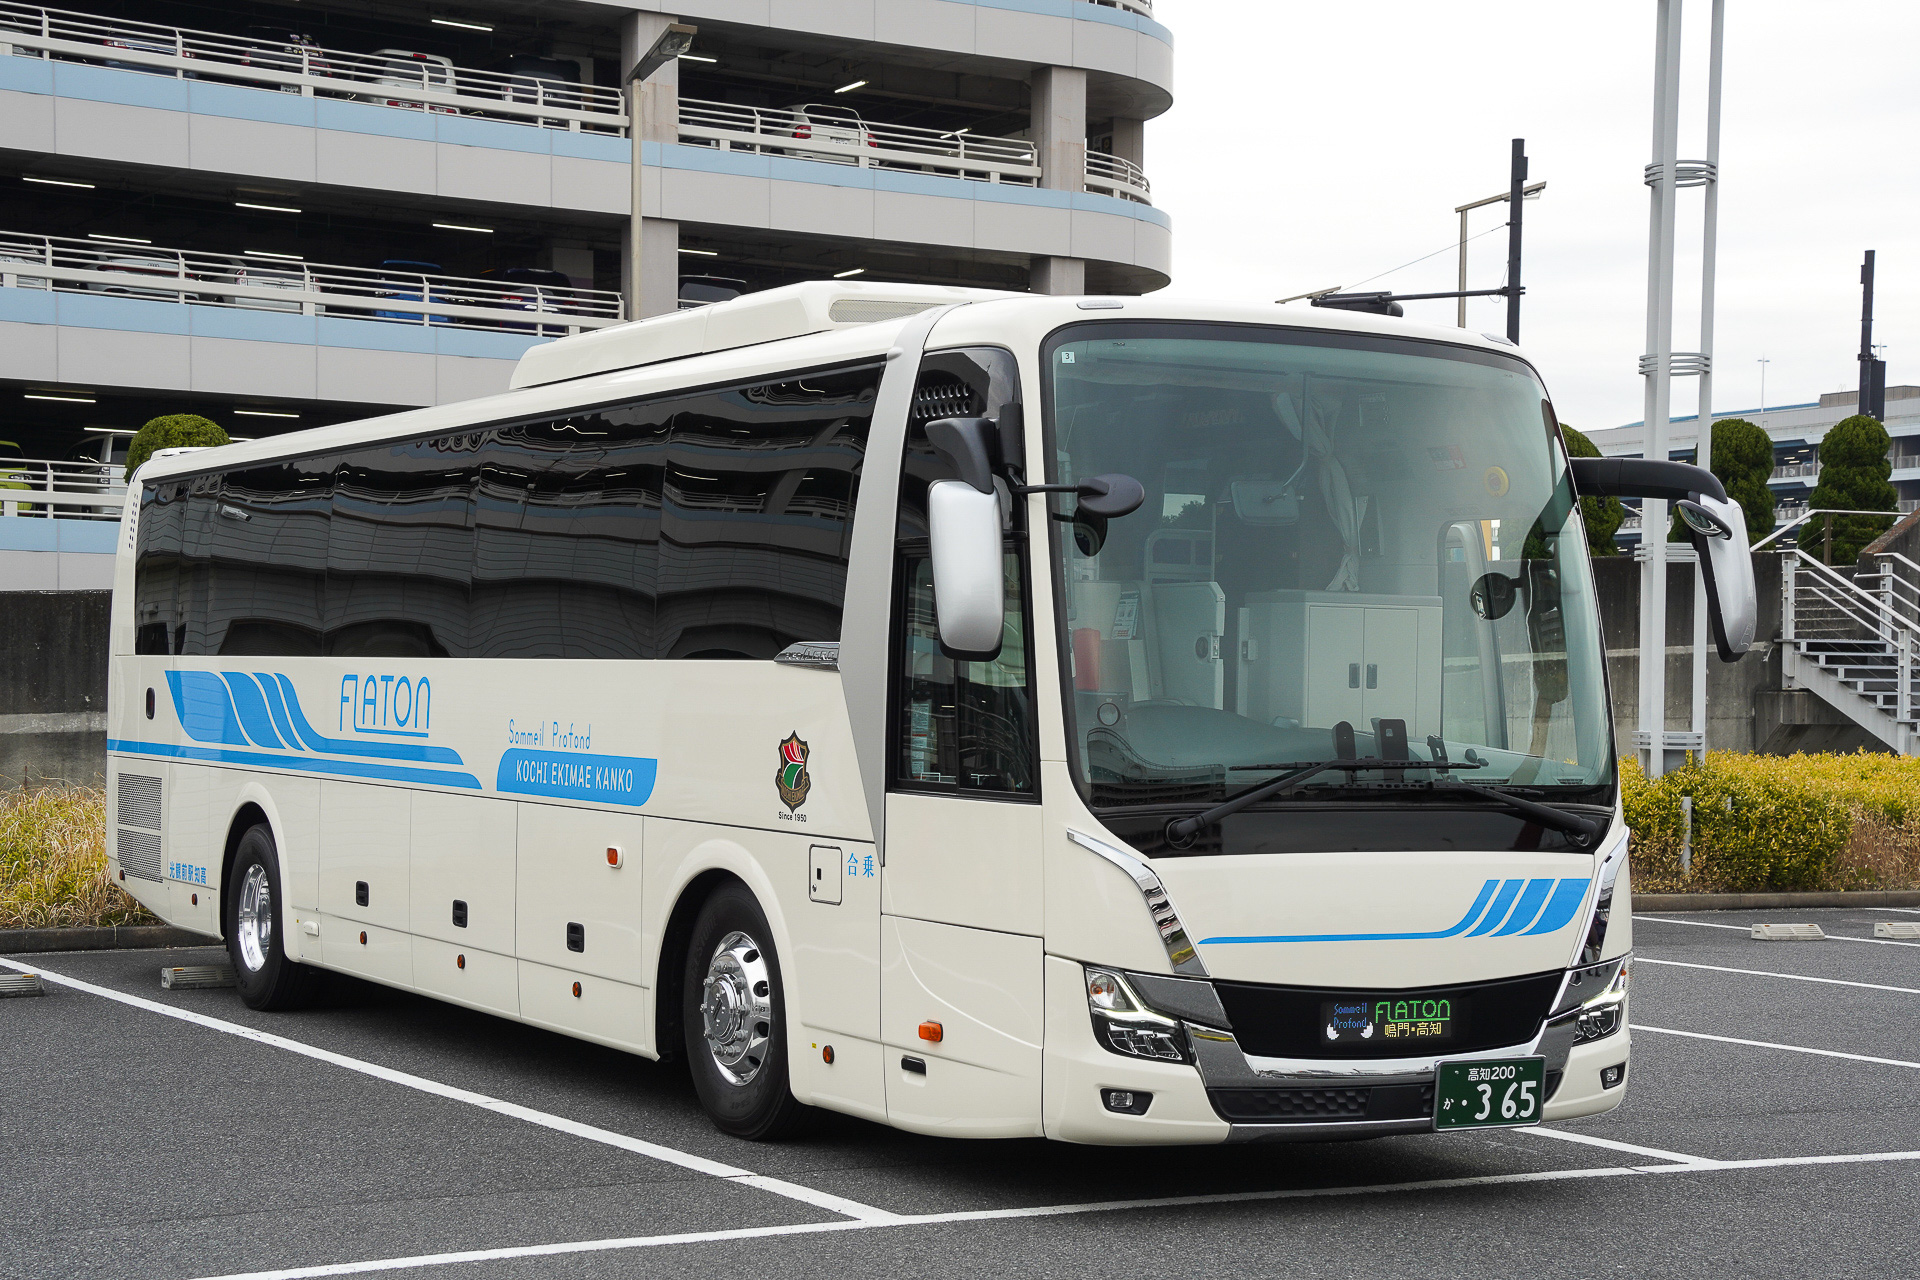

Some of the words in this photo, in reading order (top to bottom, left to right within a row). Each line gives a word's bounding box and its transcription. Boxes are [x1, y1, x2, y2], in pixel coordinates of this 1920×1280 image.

[339, 674, 431, 738] FLATON
[508, 718, 545, 747] Sommeil
[552, 721, 592, 750] Profond
[515, 759, 548, 785] KOCHI
[551, 762, 592, 789] EKIMAE
[595, 766, 634, 792] KANKO
[778, 811, 793, 821] Since
[794, 813, 807, 823] 1950
[1334, 1003, 1367, 1014] Sommeil
[1375, 1000, 1450, 1023] FLATON
[1334, 1018, 1367, 1029] Profond
[1443, 1098, 1454, 1110] か
